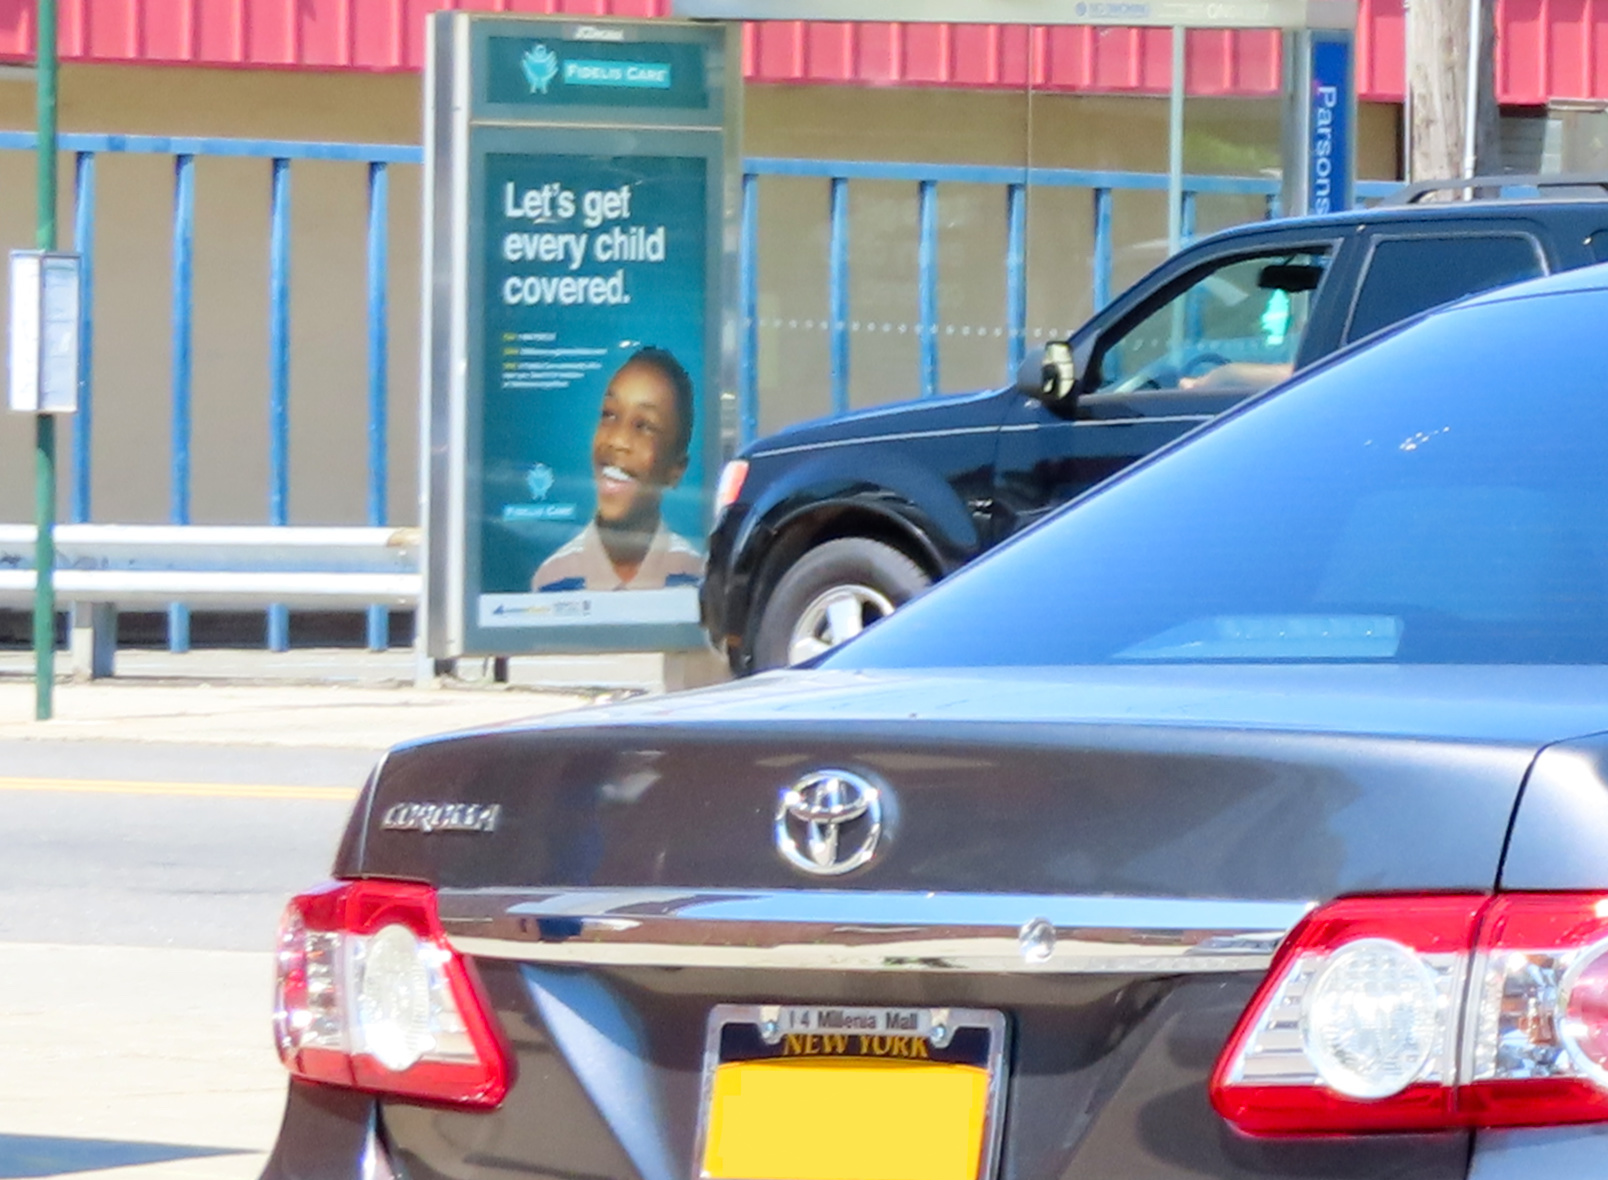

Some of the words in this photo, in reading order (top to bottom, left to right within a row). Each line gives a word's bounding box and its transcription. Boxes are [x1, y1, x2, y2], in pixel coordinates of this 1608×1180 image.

[1315, 86, 1337, 216] Parsons
[504, 181, 576, 218] Let's
[583, 184, 632, 228] get
[503, 232, 589, 270] every
[594, 225, 665, 262] child
[503, 268, 631, 305] covered.
[885, 1011, 919, 1030] Mall
[782, 1033, 849, 1057] NEW
[859, 1034, 929, 1058] YORK
